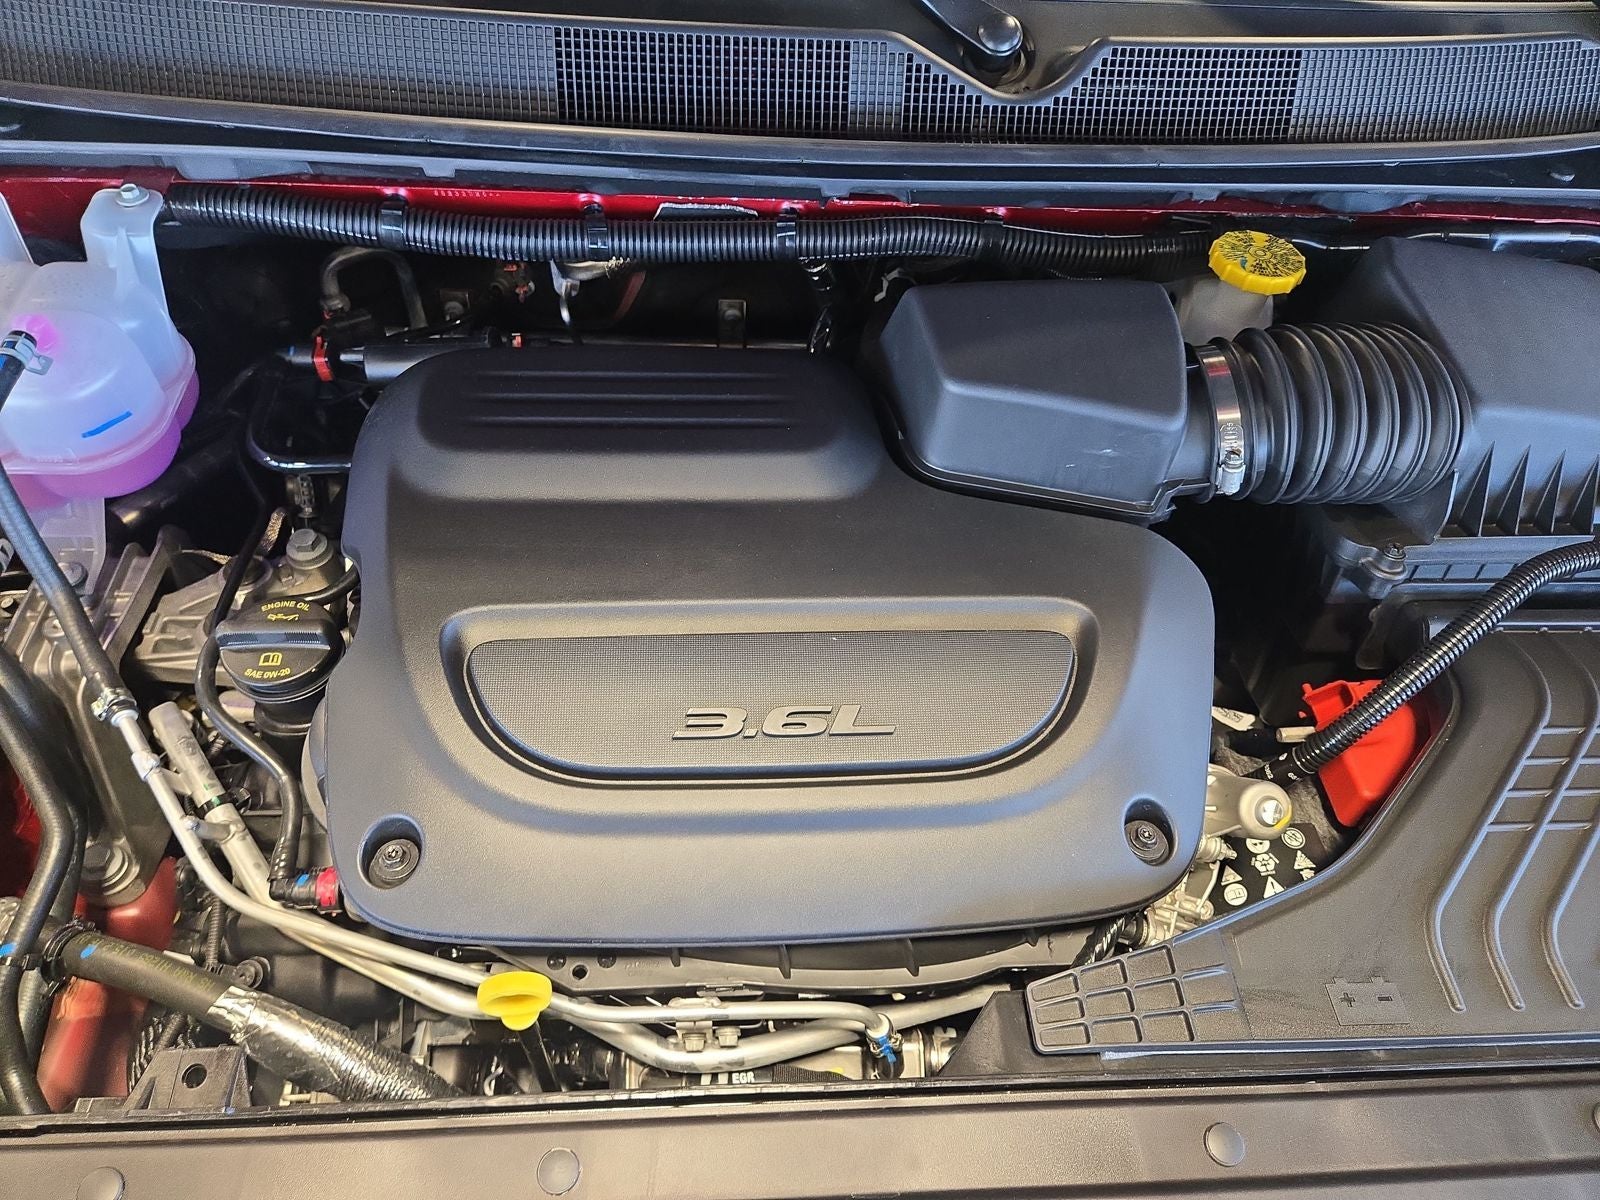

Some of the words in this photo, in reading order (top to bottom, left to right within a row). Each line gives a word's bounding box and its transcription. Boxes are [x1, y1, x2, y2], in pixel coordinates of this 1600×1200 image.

[261, 601, 296, 612] ENGINE
[296, 602, 310, 612] OIL
[244, 668, 262, 679] SAE
[263, 667, 291, 679] 0W-20
[671, 704, 897, 740] 3.6L
[732, 1071, 755, 1084] EGR
